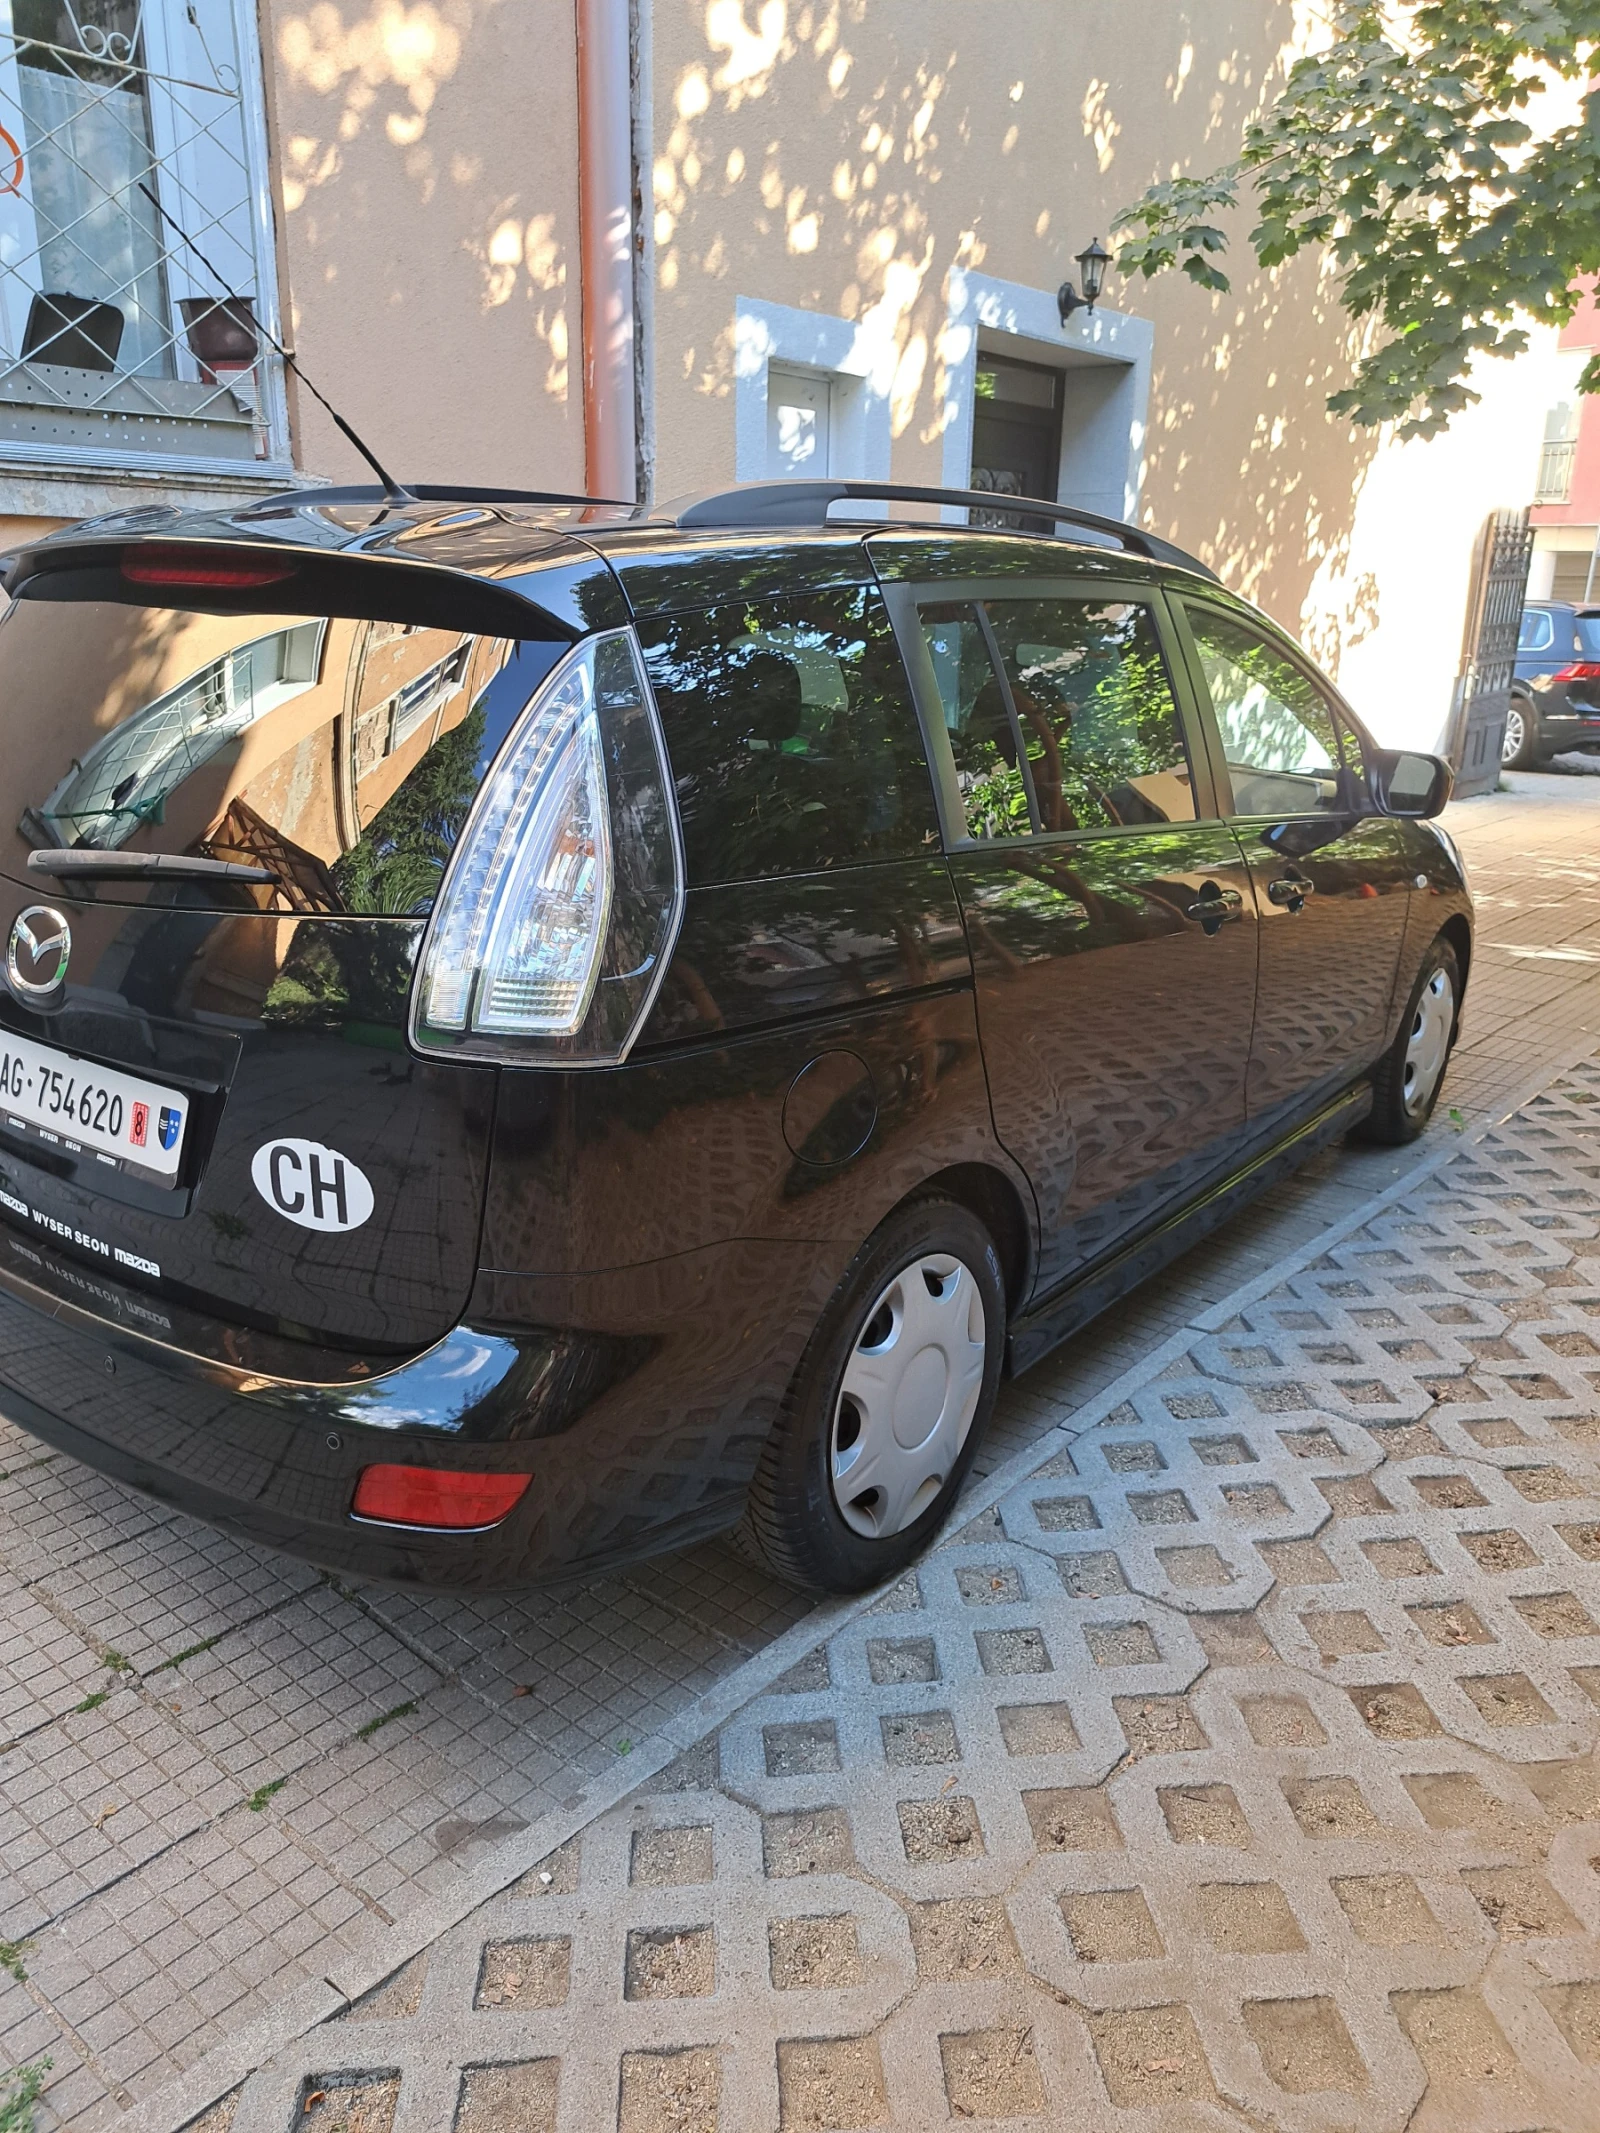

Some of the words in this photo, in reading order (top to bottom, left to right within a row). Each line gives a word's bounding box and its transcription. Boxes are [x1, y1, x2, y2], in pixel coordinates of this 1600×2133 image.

[134, 1110, 144, 1137] 8
[269, 1145, 348, 1225] CH
[32, 1208, 73, 1240] WYSER
[74, 1230, 110, 1257] SEON
[114, 1247, 161, 1278] mazda
